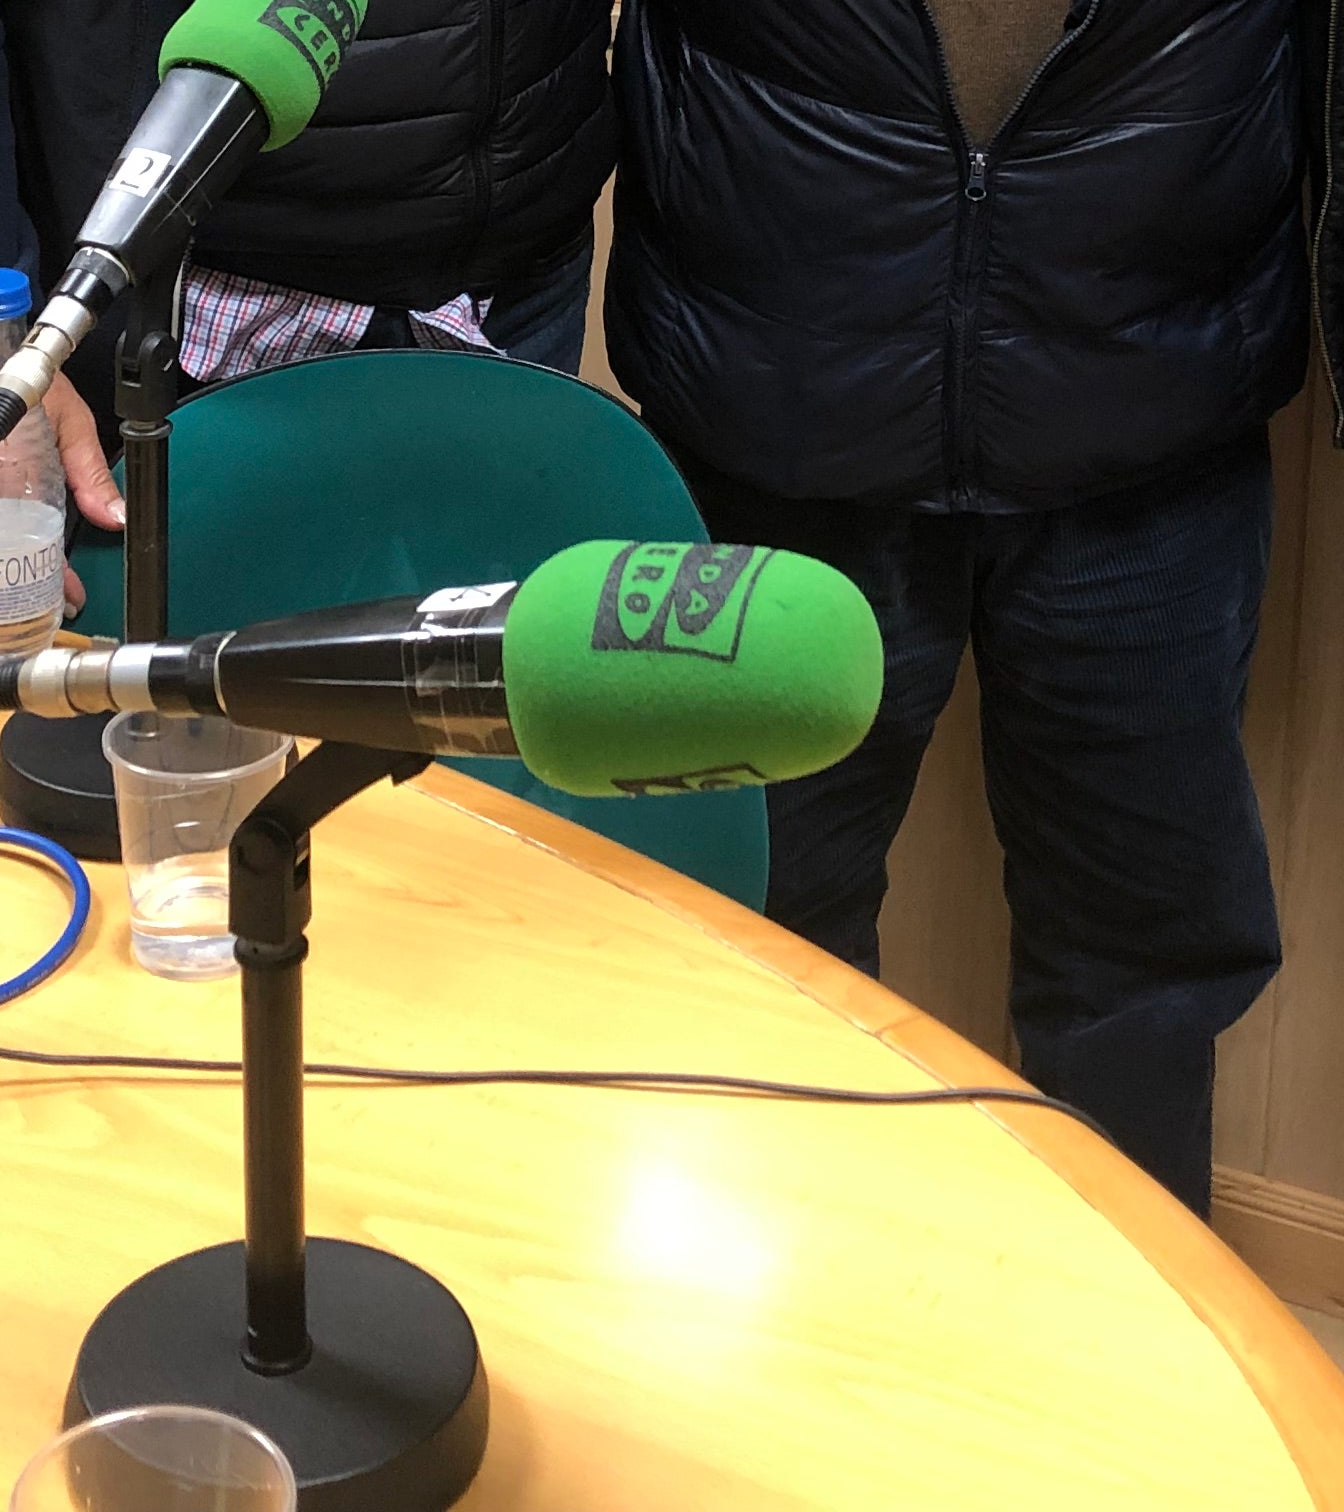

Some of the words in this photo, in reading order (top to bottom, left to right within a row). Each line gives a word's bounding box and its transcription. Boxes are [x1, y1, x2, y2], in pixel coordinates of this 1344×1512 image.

[293, 13, 338, 75] CER
[624, 546, 678, 615] ERO
[684, 544, 736, 616] NDA
